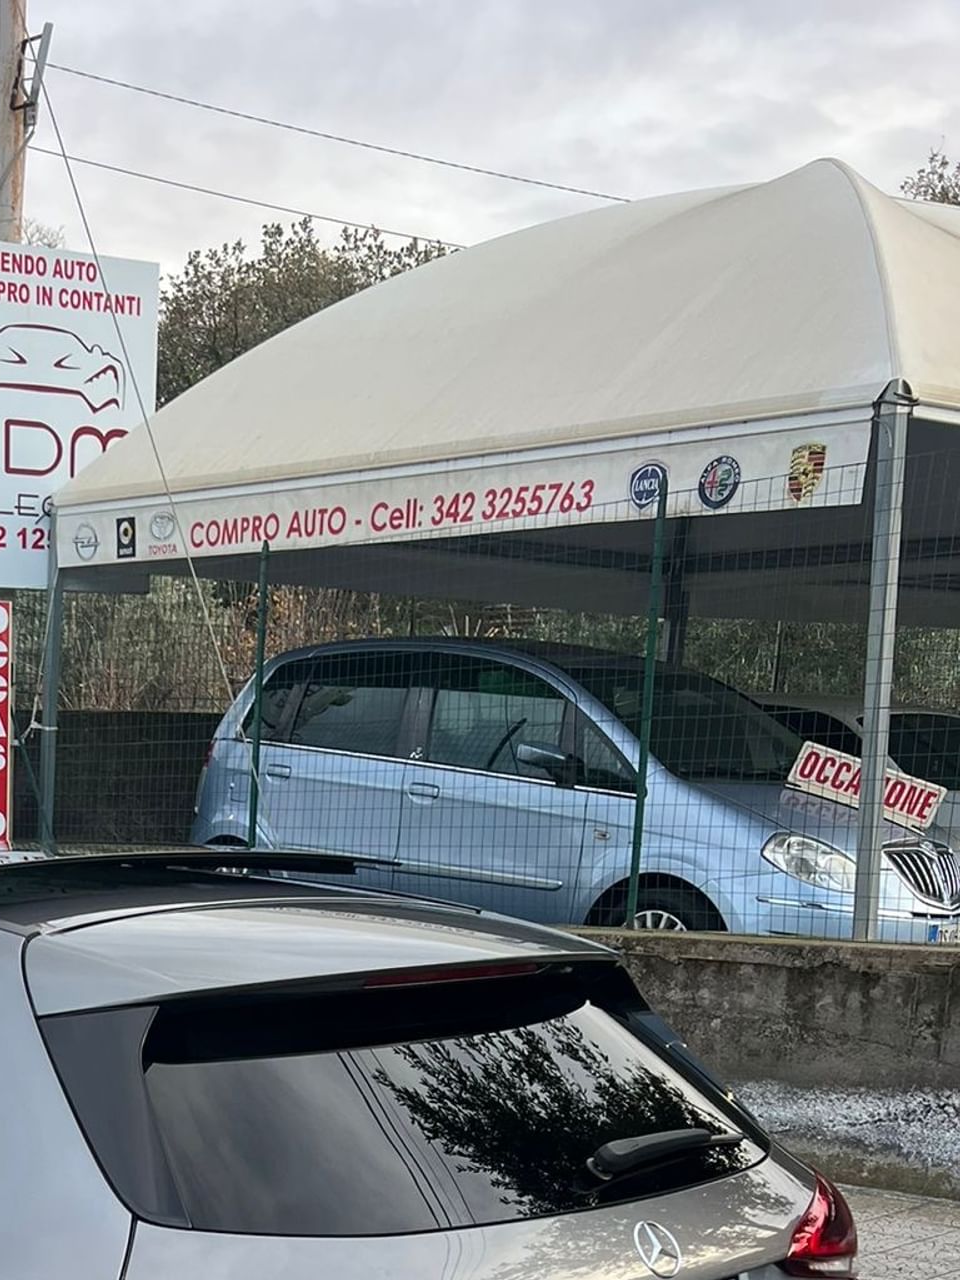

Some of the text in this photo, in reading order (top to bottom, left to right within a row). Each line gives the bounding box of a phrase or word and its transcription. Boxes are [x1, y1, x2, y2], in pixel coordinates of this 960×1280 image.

[52, 258, 98, 283] AUTO
[35, 286, 53, 308] IN
[58, 287, 142, 317] CONTANTI
[190, 513, 280, 548] COMPRO
[286, 507, 346, 539] AUTO
[371, 498, 422, 532] Cell:
[431, 492, 474, 527] 342
[482, 479, 596, 521] 3255763
[17, 527, 51, 550] 12
[148, 544, 178, 556] TOYOTA
[798, 751, 938, 821] OCCAONE
